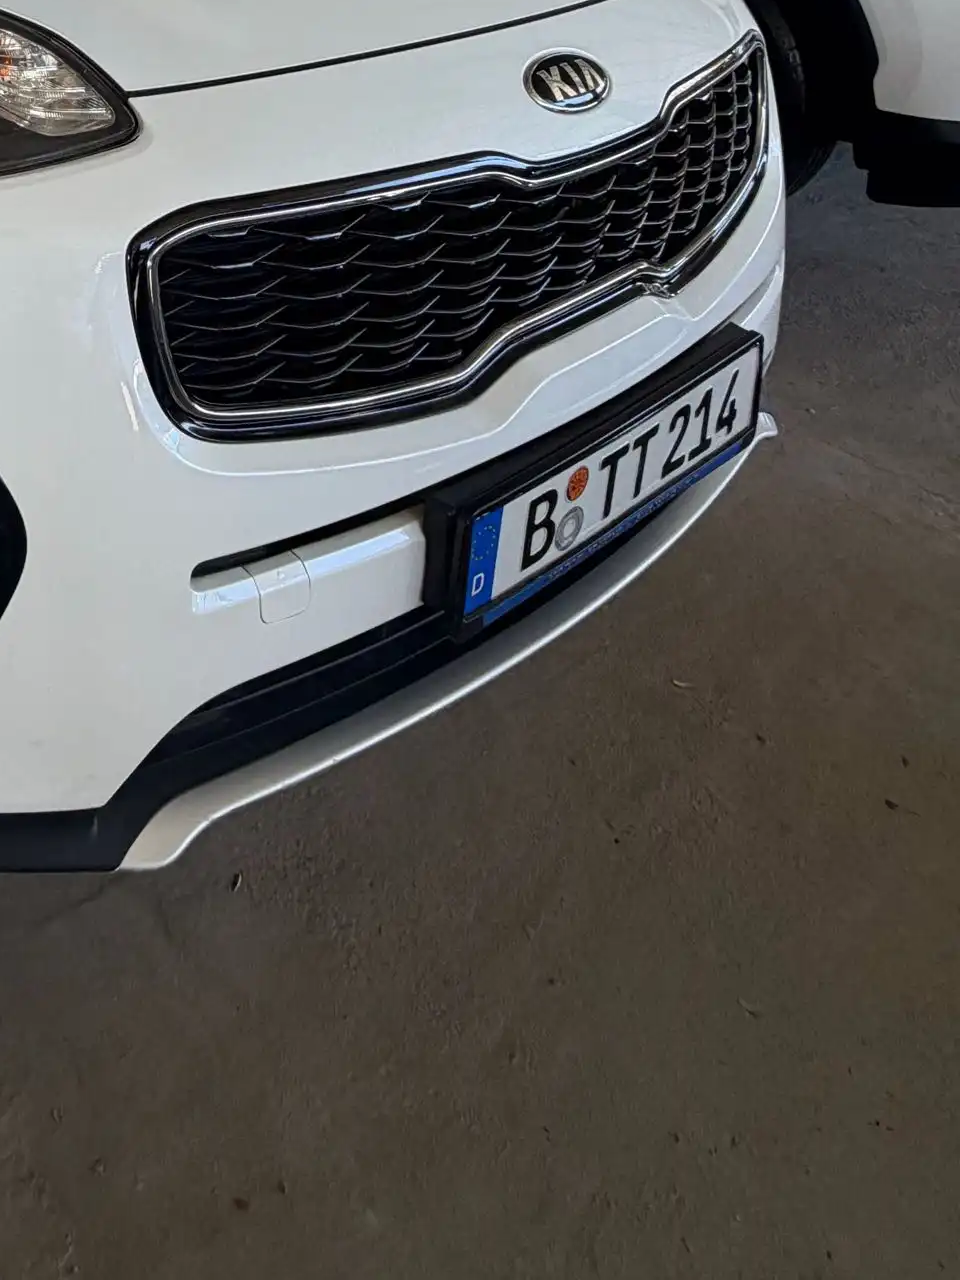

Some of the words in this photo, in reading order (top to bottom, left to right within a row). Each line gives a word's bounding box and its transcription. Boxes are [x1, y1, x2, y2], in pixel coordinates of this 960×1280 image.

[536, 59, 605, 101] KIA
[521, 489, 559, 572] B
[600, 422, 659, 519] TT
[661, 369, 740, 480] 214
[471, 572, 485, 598] D
